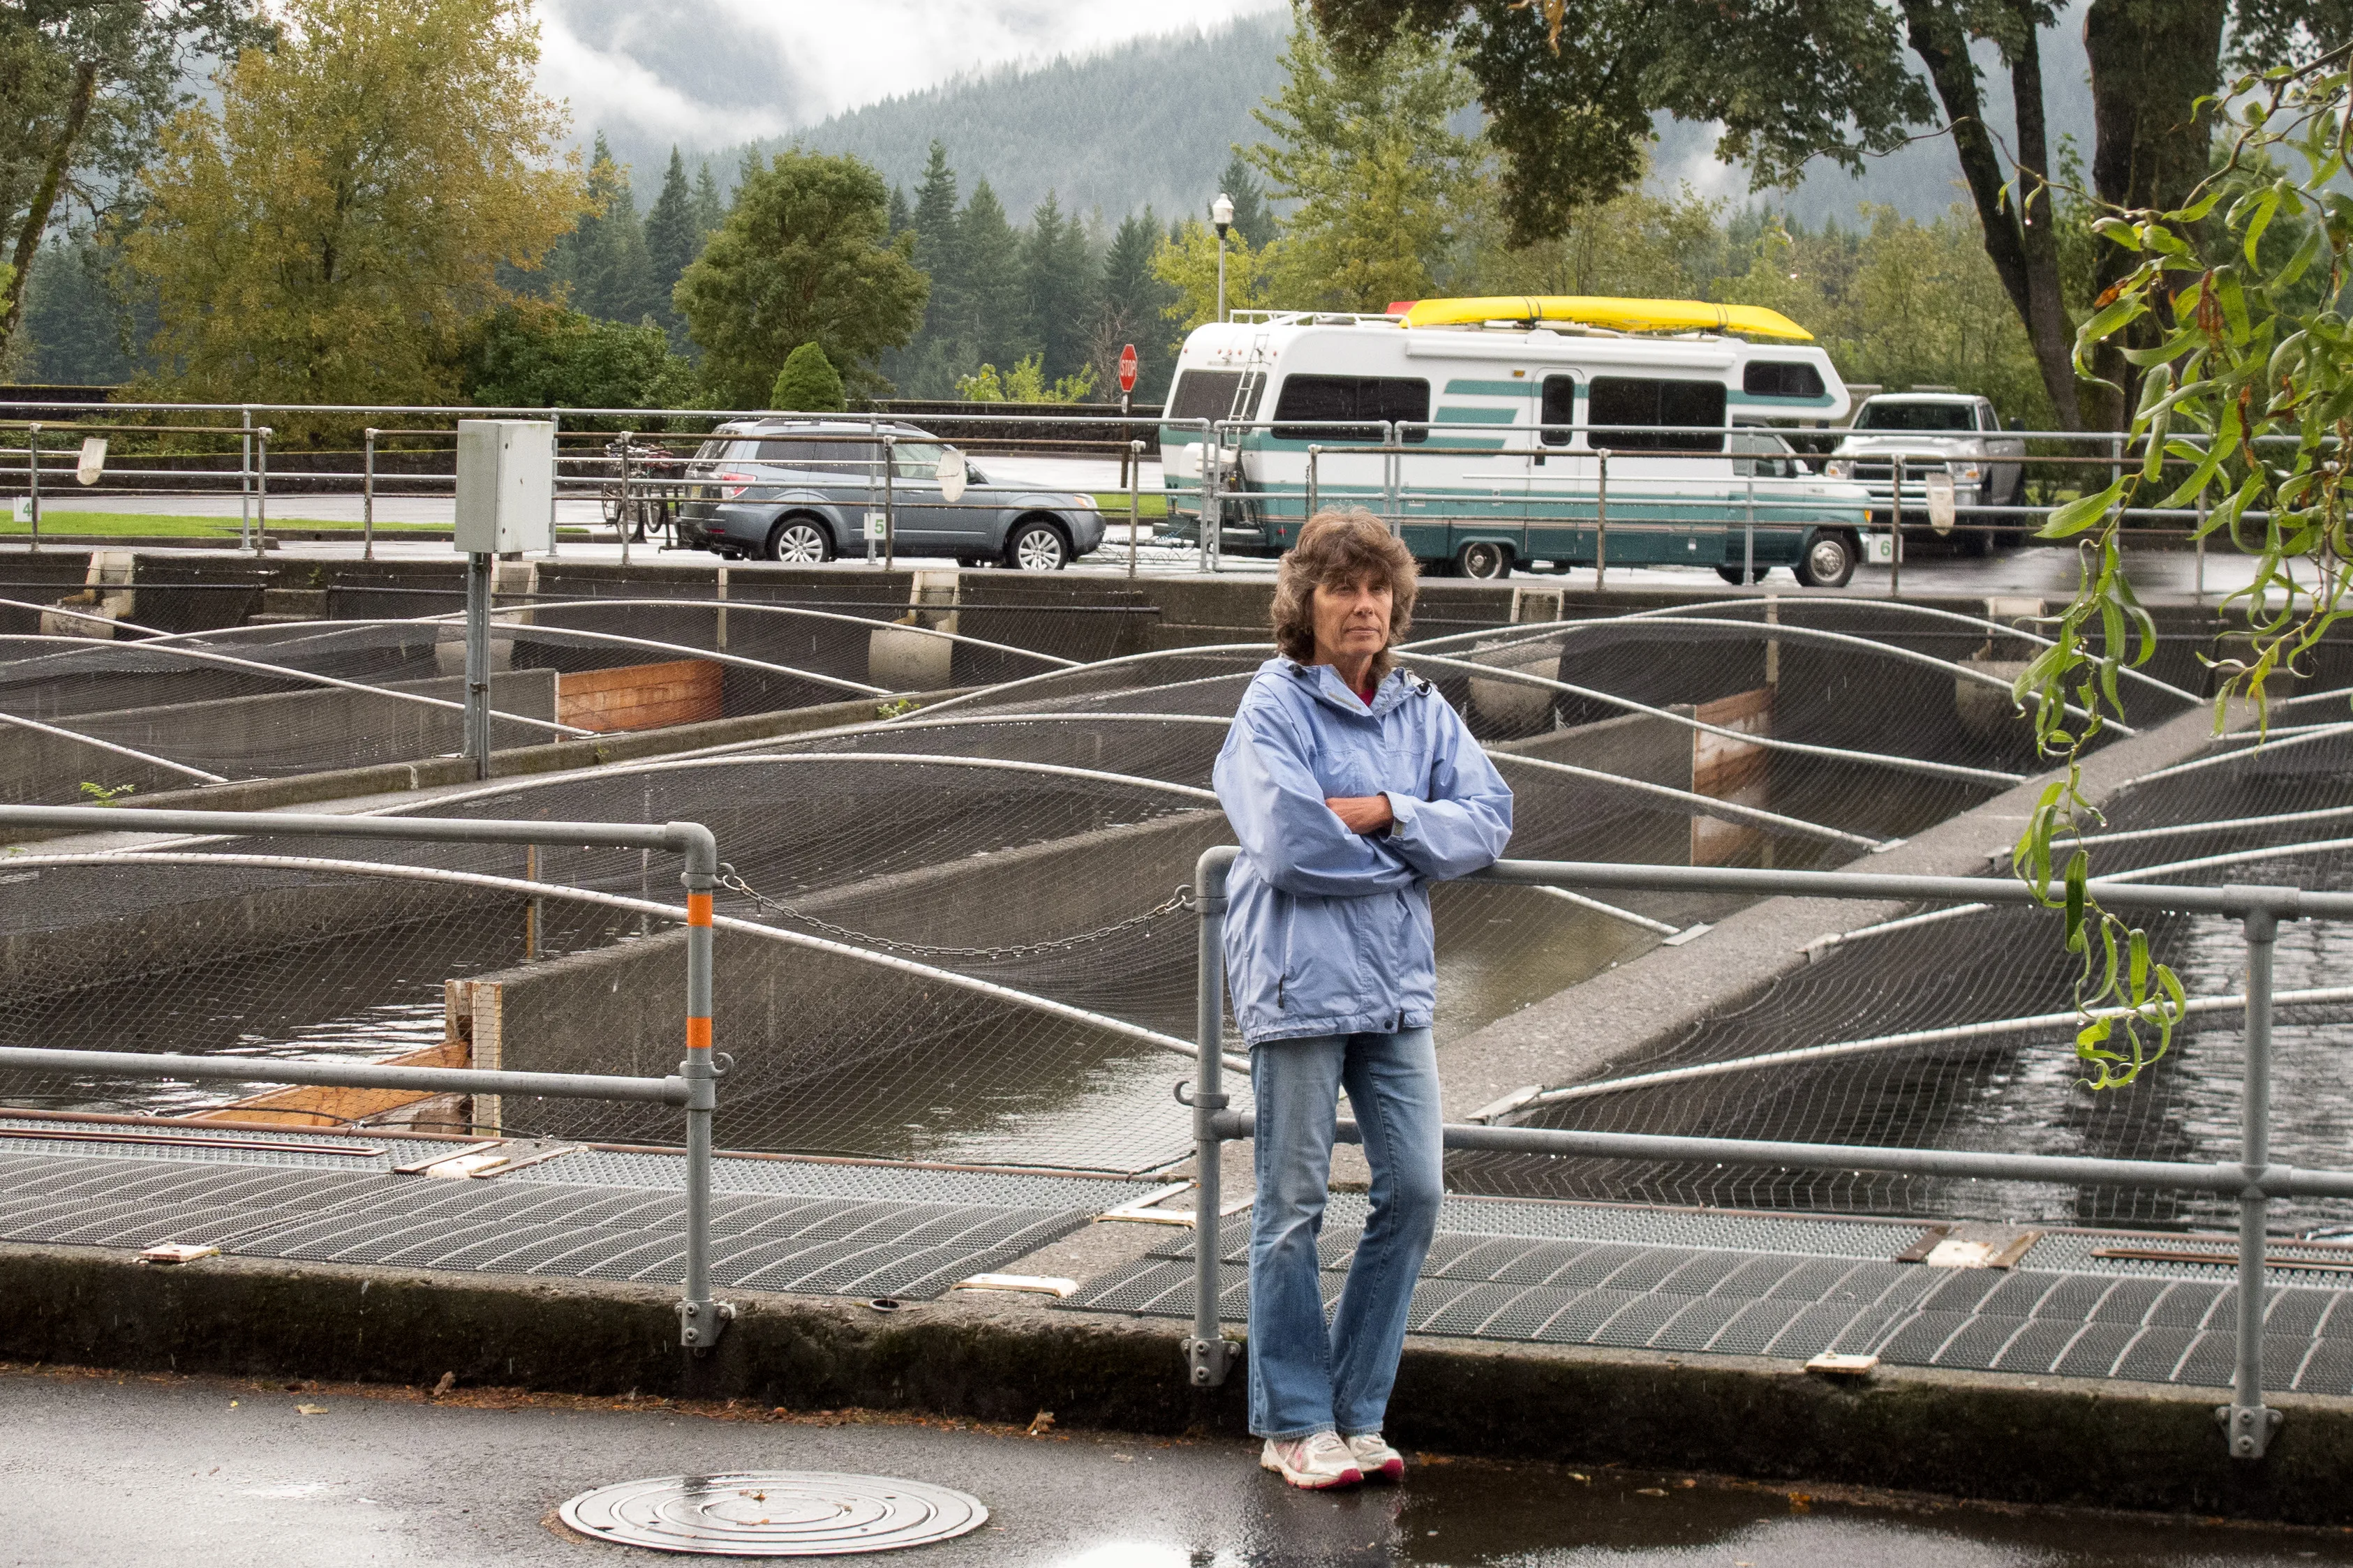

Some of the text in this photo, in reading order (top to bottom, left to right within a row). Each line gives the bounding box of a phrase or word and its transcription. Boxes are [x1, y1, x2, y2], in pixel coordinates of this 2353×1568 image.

[1121, 359, 1136, 377] STOP
[22, 502, 32, 517] 4
[875, 518, 884, 534] 5
[1880, 540, 1890, 556] 6
